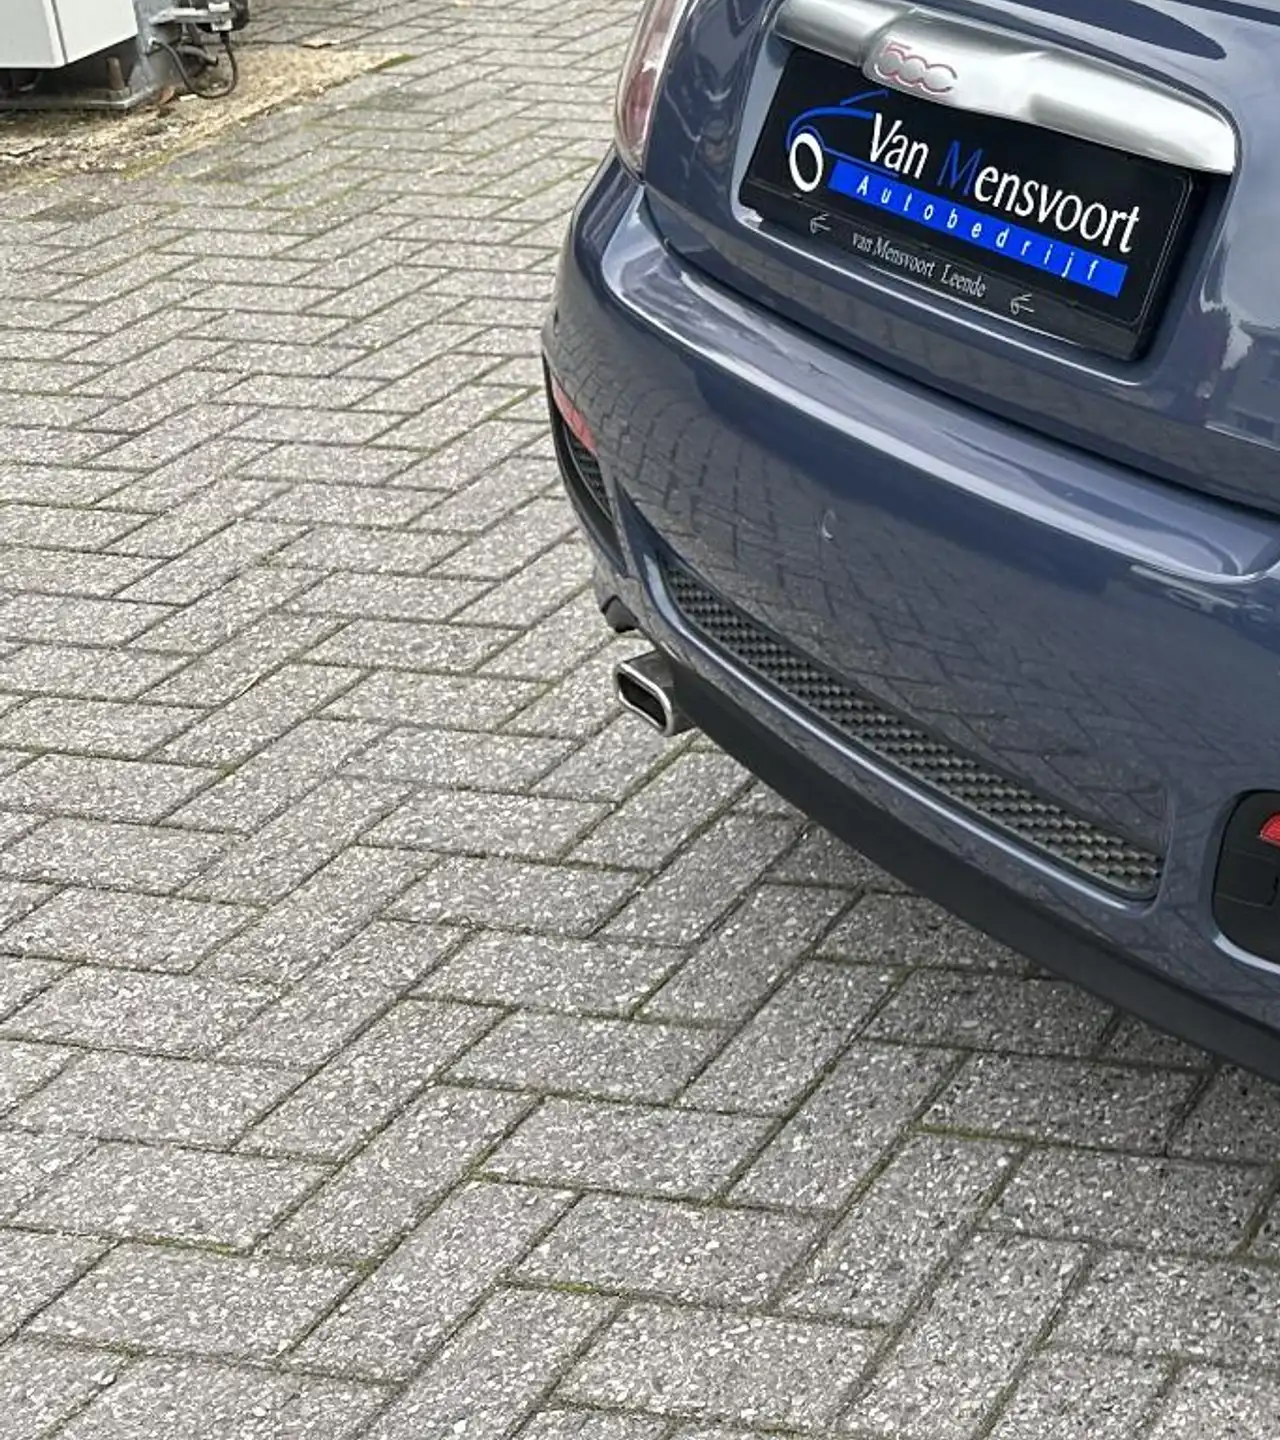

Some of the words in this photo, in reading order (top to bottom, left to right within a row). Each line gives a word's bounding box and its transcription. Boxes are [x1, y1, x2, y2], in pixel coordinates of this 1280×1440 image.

[856, 174, 1099, 279] Autobedrijf
[869, 112, 930, 179] Van
[936, 139, 1140, 253] Mensvoort
[873, 236, 936, 279] Mensvoort
[940, 262, 988, 298] Leende
